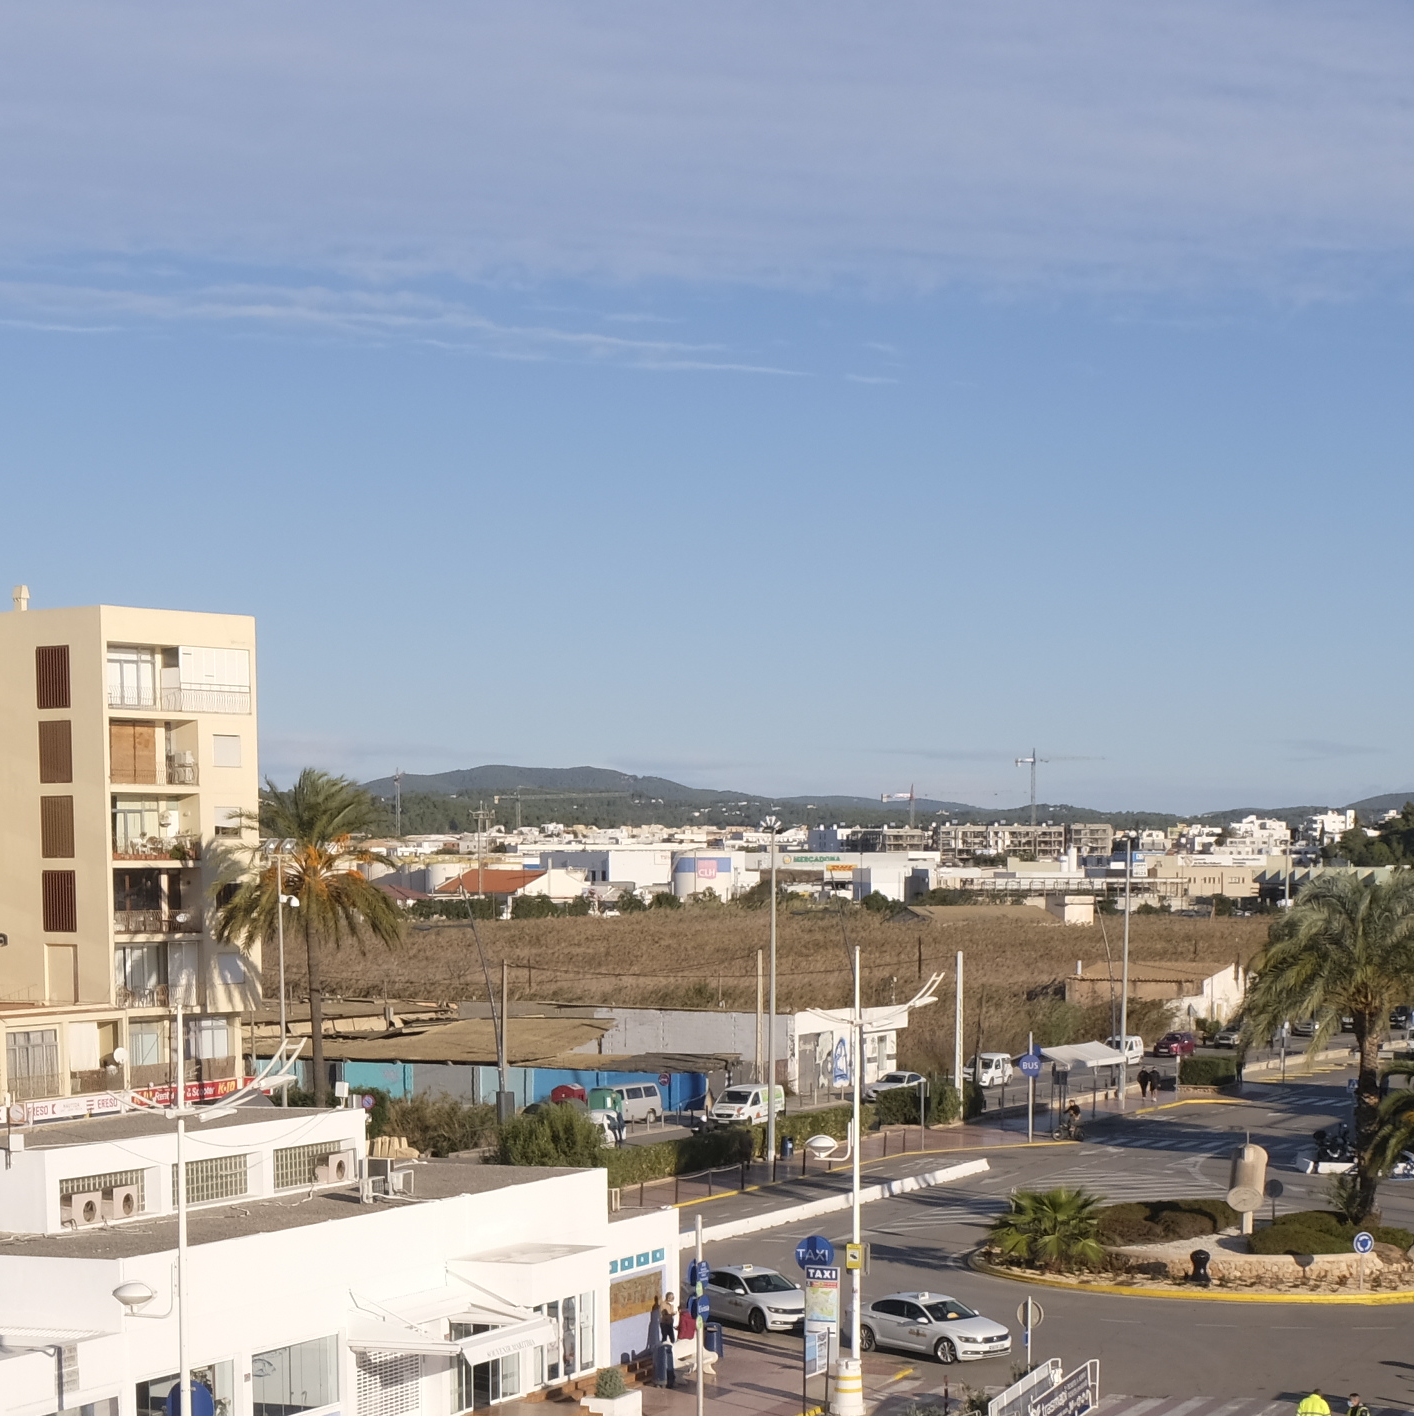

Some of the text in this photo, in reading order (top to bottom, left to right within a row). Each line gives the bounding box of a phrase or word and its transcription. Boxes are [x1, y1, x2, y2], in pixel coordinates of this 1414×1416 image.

[699, 869, 715, 877] CLH
[1023, 1062, 1039, 1070] BUS
[97, 1099, 118, 1110] ERESO
[797, 1249, 829, 1261] TAXI
[808, 1269, 836, 1279] TAXI
